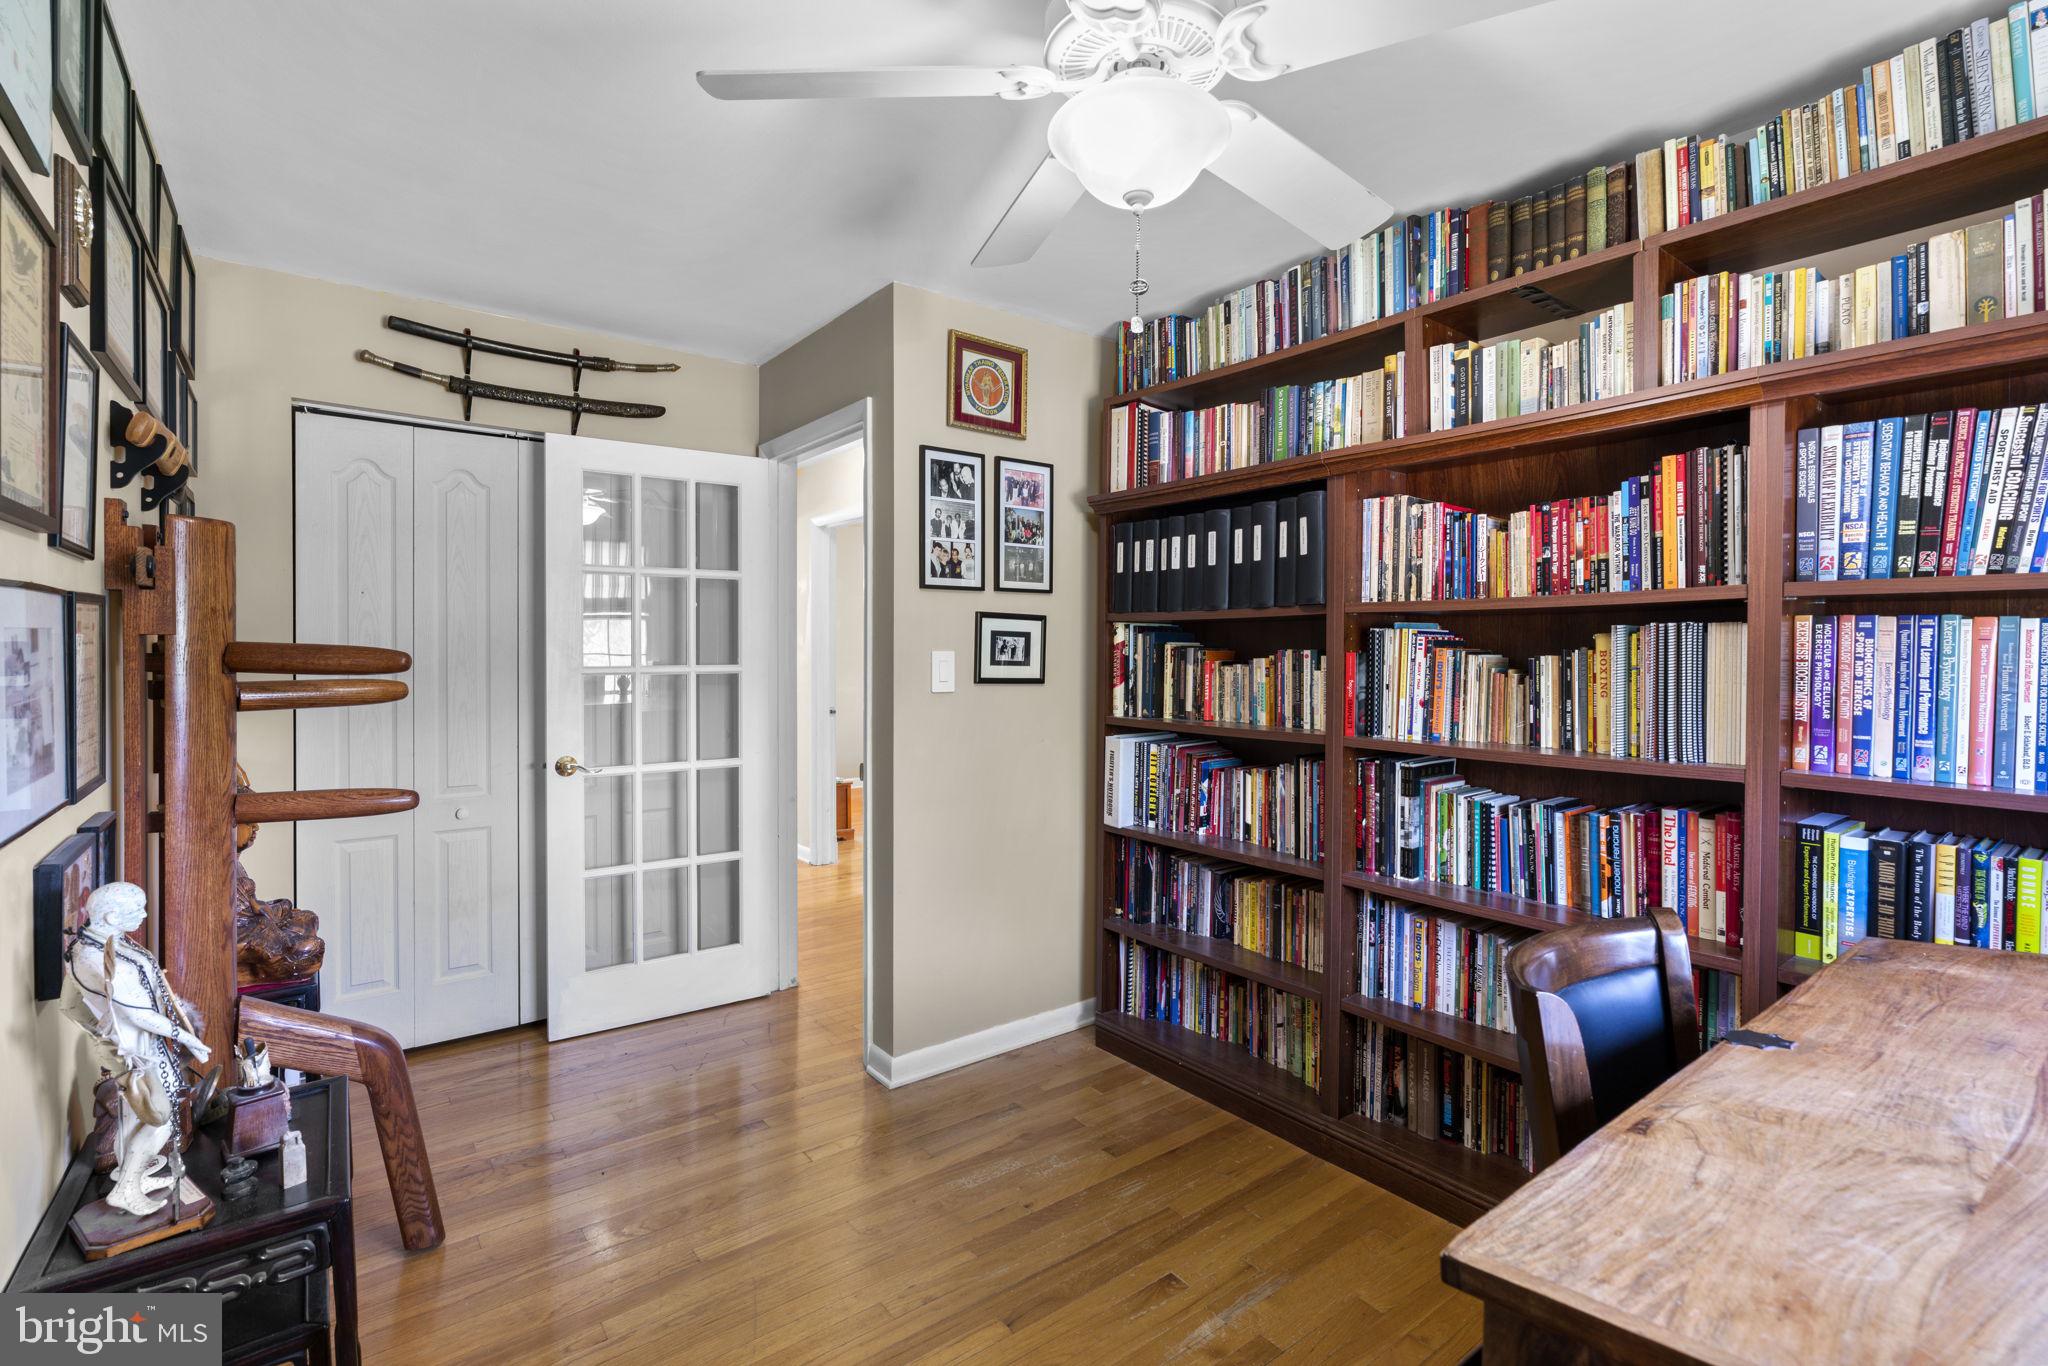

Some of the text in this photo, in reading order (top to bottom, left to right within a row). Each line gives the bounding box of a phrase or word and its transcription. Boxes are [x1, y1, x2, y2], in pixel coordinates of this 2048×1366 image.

[1923, 46, 1933, 69] Words
[1976, 49, 1992, 120] SILENT SPRING
[1842, 296, 1851, 325] PLATO
[1860, 440, 1869, 485] ESSENTIALS
[1924, 440, 1937, 496] Training Programs
[1997, 429, 2009, 458] SPORT
[1820, 446, 1837, 541] SCIENCE OF FLEXIBILITY
[1850, 441, 1860, 519] STRENGTH TRAINING
[1876, 423, 1893, 538] SEDENTARY BEHAVIOR AND HEALTH
[1933, 439, 1949, 506] Designing Resistance
[1988, 489, 1997, 504] AID
[1991, 461, 2004, 485] FIRST
[1996, 416, 2033, 548] Successful COACHING Martens
[1677, 506, 1684, 514] DO
[1600, 650, 1608, 698] BOXING
[1795, 621, 1809, 721] EXERCISE BIOCHEMISTRY
[1853, 632, 1864, 715] SPORT AND EXERCISE
[1864, 638, 1873, 709] BIOMECHANICS OF
[1918, 628, 1933, 734] Motor Learning and Performance
[1939, 620, 1956, 701] Exercise Psychology
[1978, 645, 1988, 732] Sports Exercise Nutrition
[1822, 682, 1830, 719] CELLULAR
[2000, 665, 2012, 731] Human Movement
[1664, 815, 1676, 837] The
[1664, 840, 1676, 866] Duel
[1702, 852, 1710, 880] Medieval
[1878, 860, 1896, 915] OF THE BODY
[1911, 849, 1924, 939] The Wisdom of the Body
[1938, 854, 1954, 888] SPARK
[2021, 867, 2036, 909] BOUNCE
[1845, 860, 1856, 936] Building EXPERTISE
